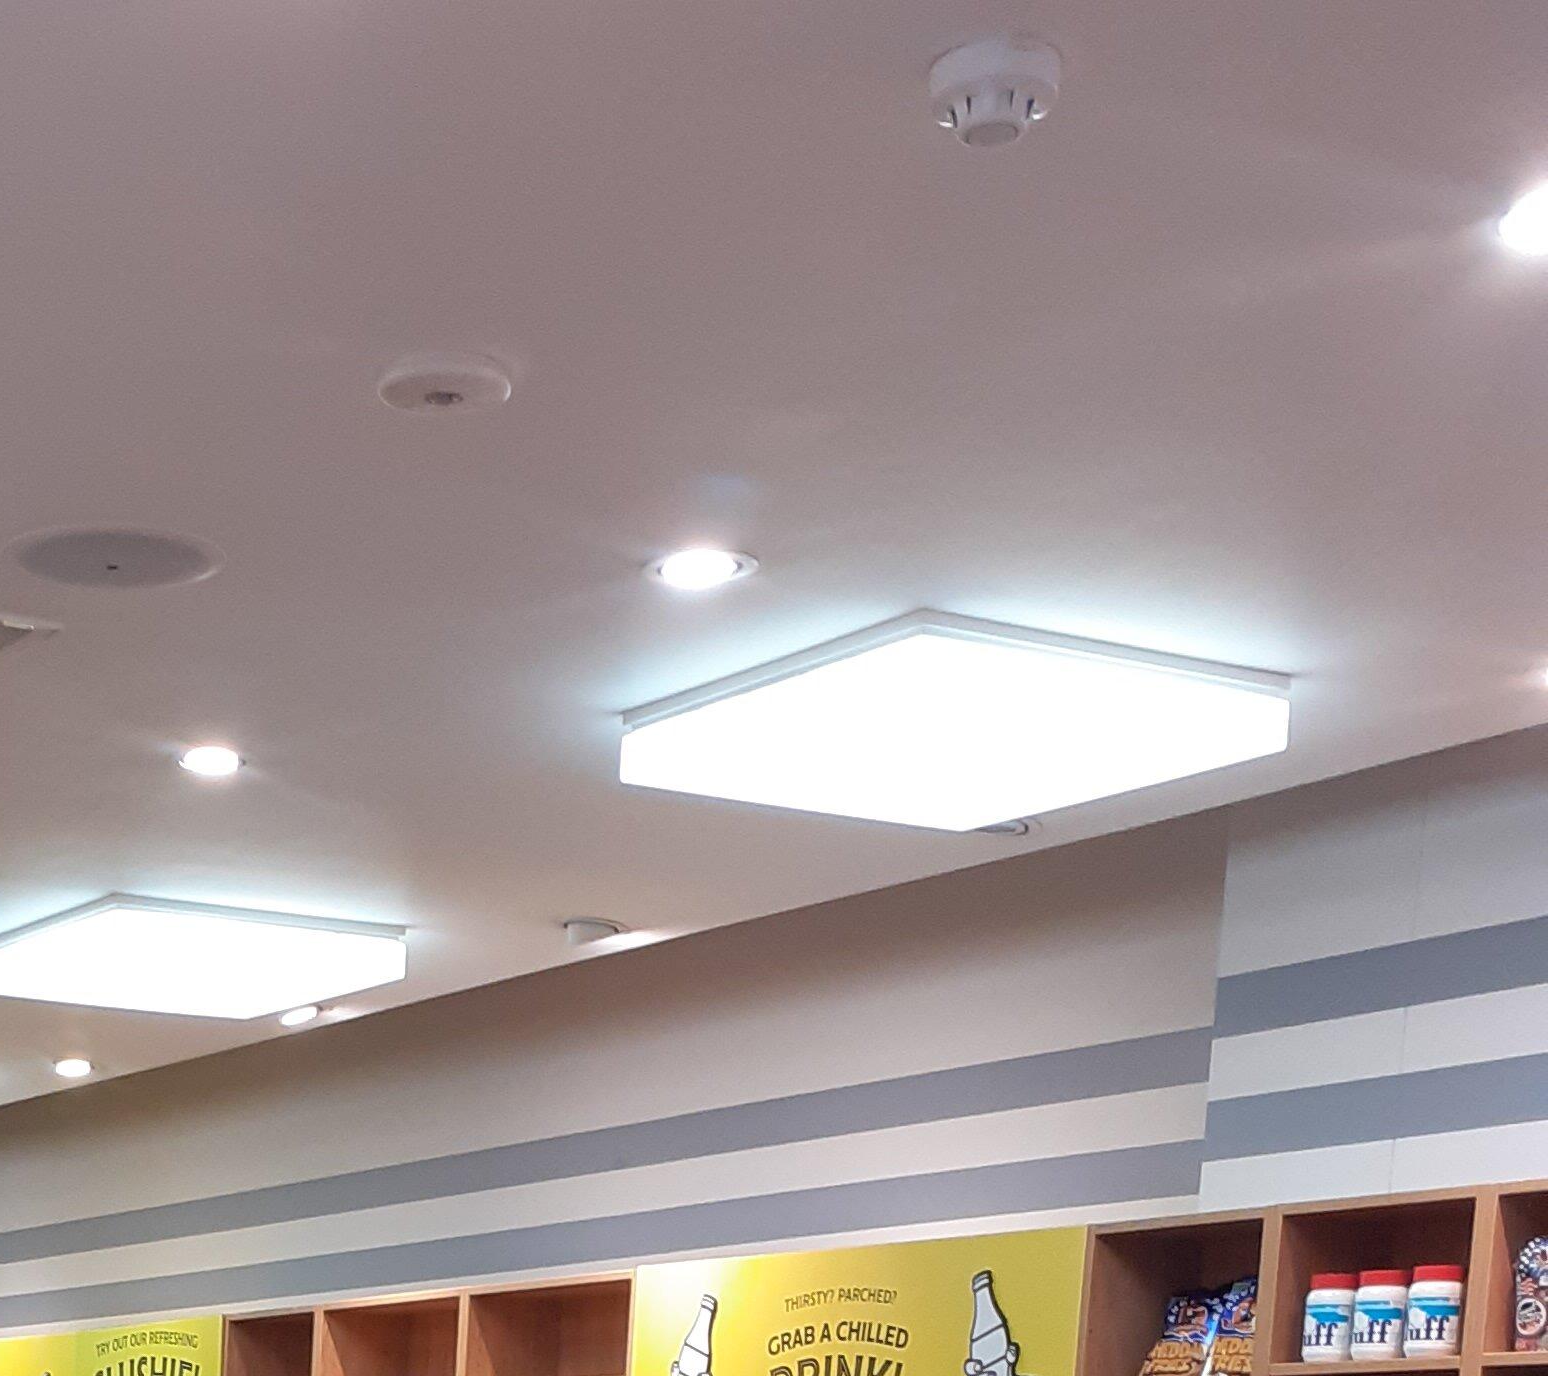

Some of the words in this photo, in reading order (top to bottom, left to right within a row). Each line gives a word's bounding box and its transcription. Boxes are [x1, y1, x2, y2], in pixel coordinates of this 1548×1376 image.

[784, 1289, 834, 1312] THIRSTY?
[838, 1288, 897, 1304] PARCHED?
[768, 1326, 815, 1355] GRAB
[820, 1323, 832, 1343] A
[836, 1321, 909, 1348] CHILLED
[1303, 1323, 1339, 1347] uff
[1354, 1320, 1392, 1344] uff
[1409, 1316, 1449, 1342] uff
[96, 1340, 110, 1357] TRY
[112, 1335, 128, 1351] OUT
[129, 1331, 147, 1347] OUR
[149, 1331, 198, 1348] REFRESHING
